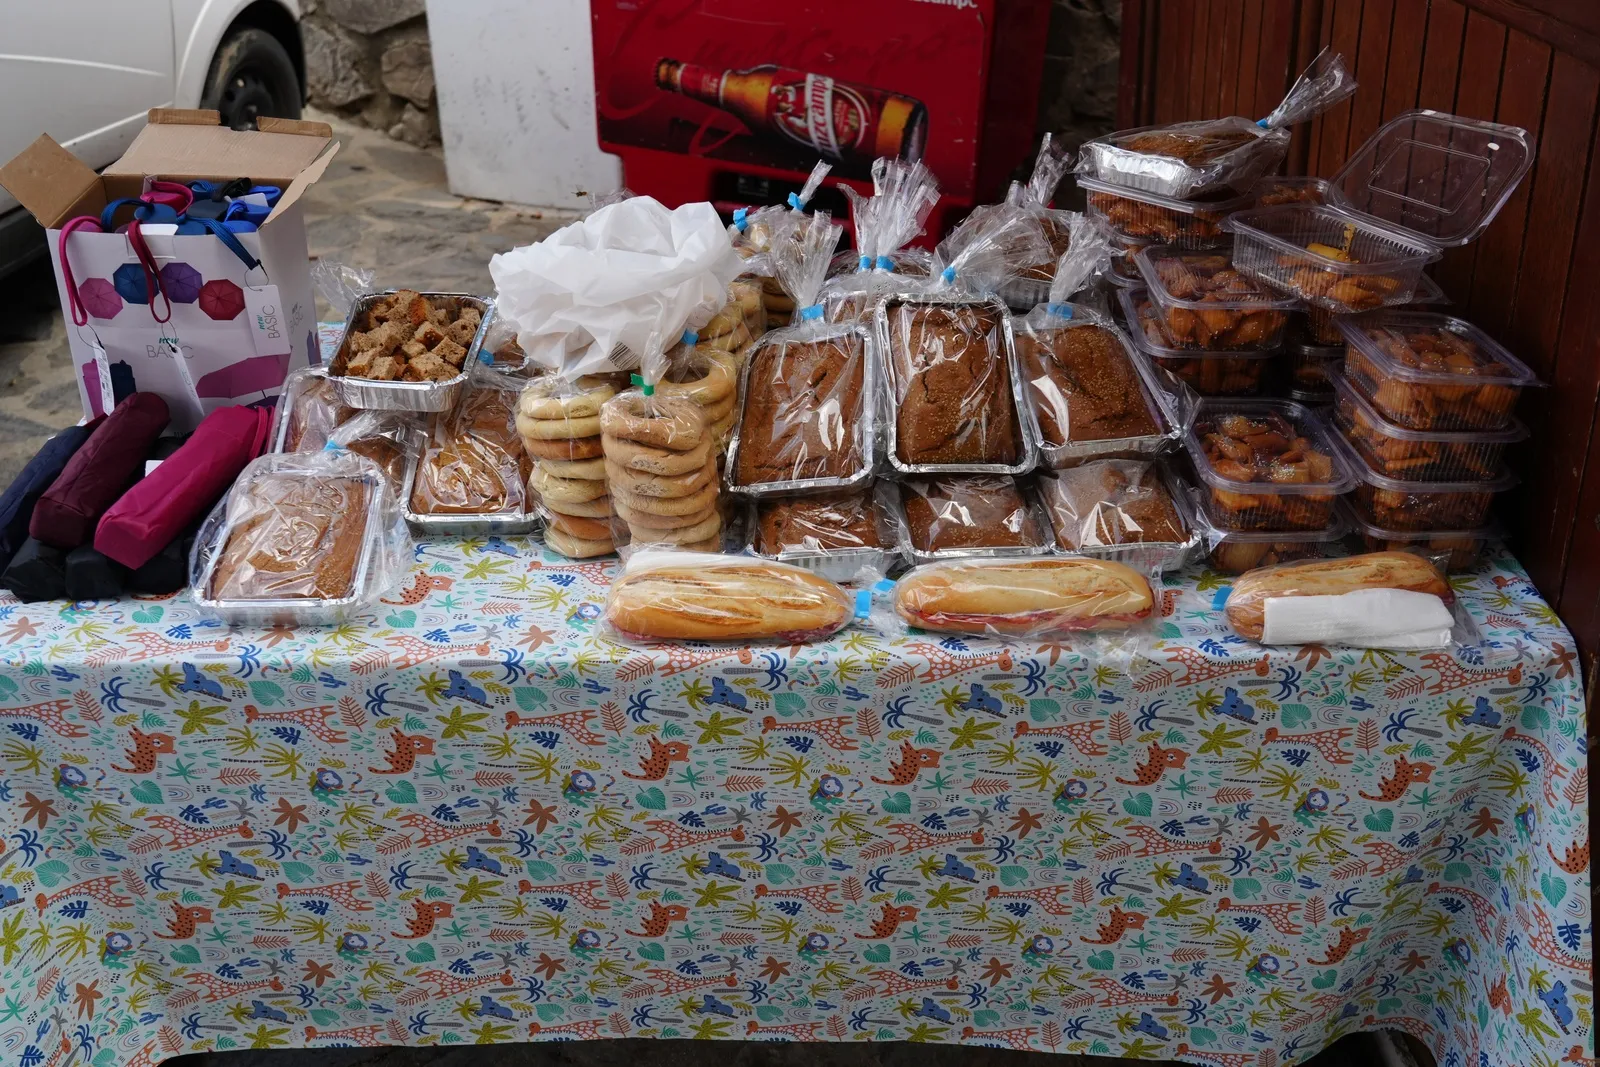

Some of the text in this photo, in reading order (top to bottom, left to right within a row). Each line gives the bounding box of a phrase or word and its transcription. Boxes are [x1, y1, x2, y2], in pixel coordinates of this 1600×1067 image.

[256, 314, 266, 331] new
[262, 304, 281, 339] BASIC
[145, 344, 195, 360] BASC
